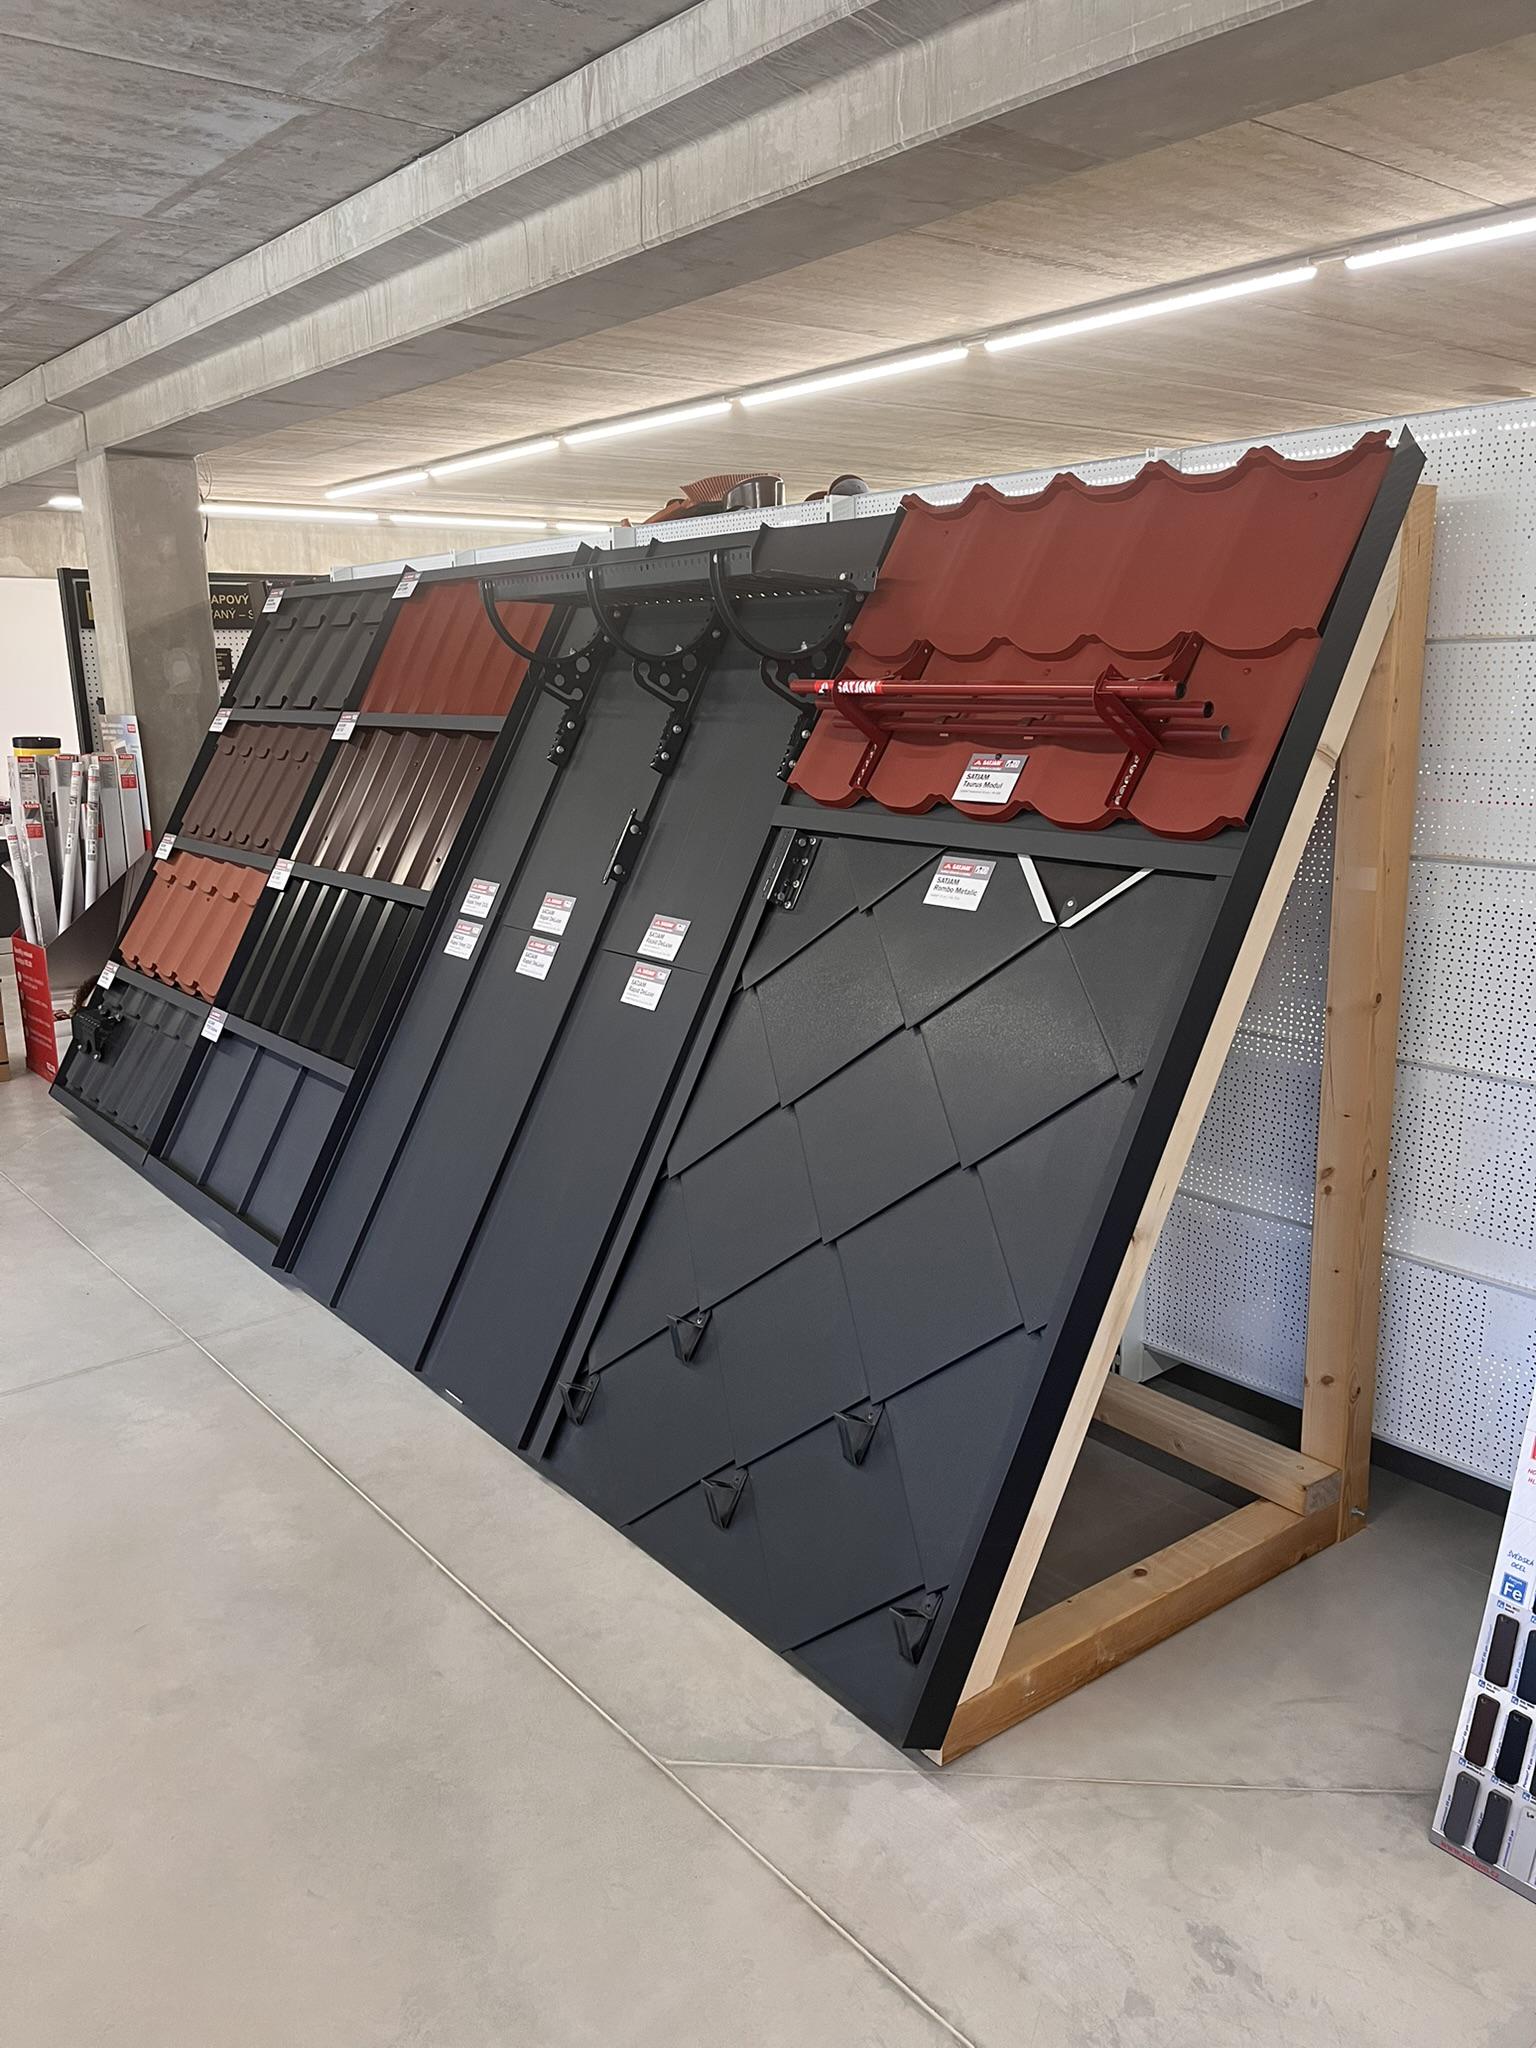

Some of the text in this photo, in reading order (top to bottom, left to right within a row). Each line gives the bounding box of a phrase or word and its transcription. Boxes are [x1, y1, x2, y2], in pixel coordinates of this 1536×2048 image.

[212, 607, 236, 619] ANÝ
[838, 681, 876, 694] SATJAM
[937, 877, 960, 885] SATJAM
[933, 884, 954, 893] Rombo
[955, 887, 978, 897] Metalic
[1503, 1581, 1523, 1601] Fe
